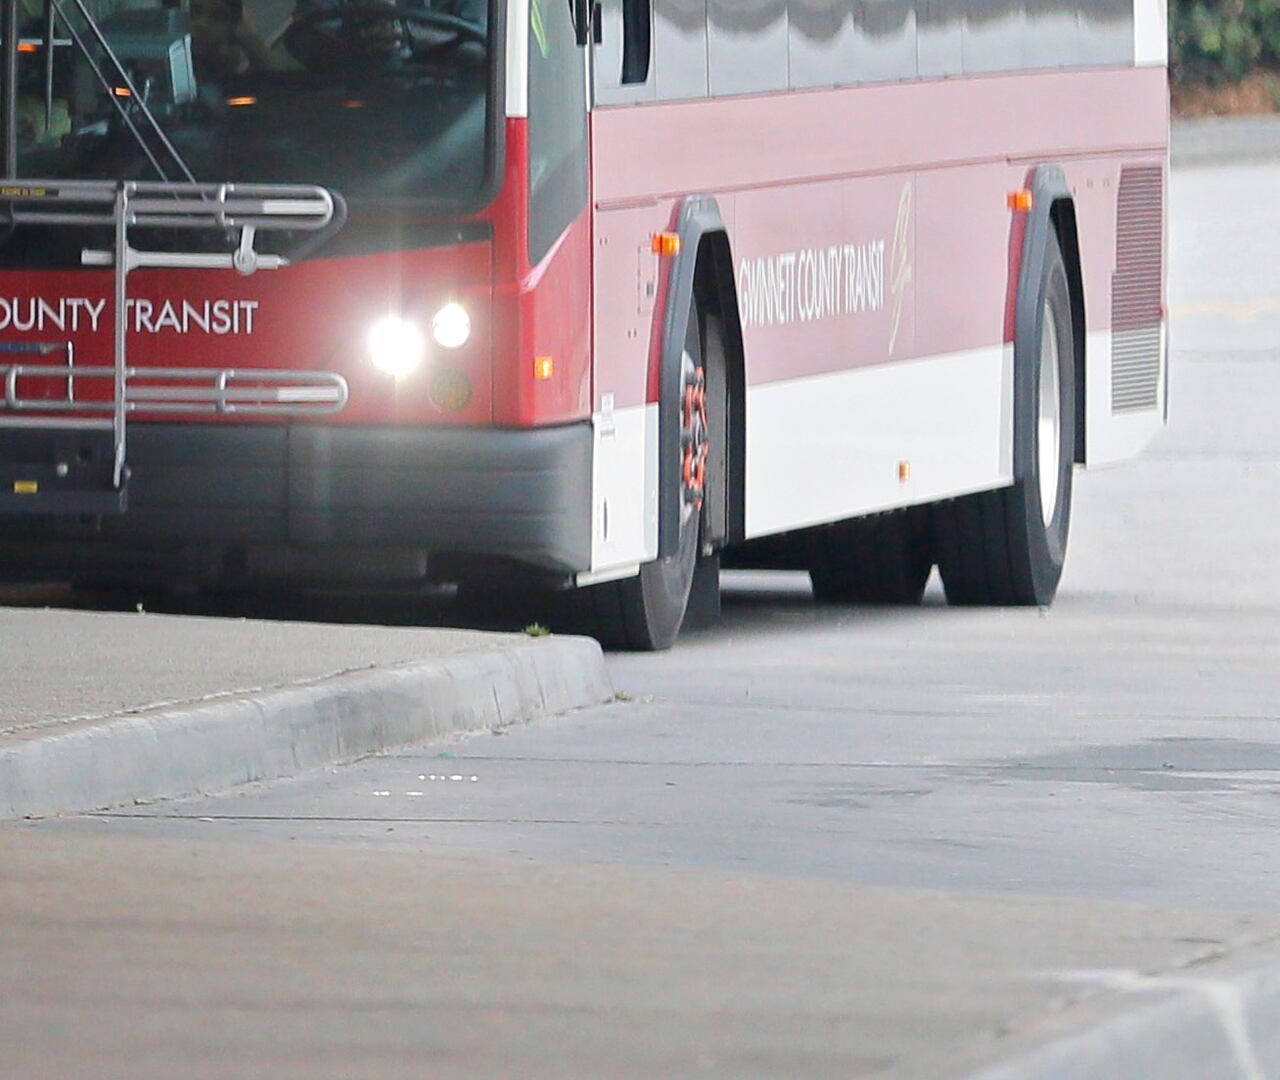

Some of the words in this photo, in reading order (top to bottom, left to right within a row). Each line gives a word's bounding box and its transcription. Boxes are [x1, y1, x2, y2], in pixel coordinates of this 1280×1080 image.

[797, 246, 842, 323] COUNTY
[843, 239, 885, 315] TRANSIT
[124, 298, 259, 334] TRANSIT
